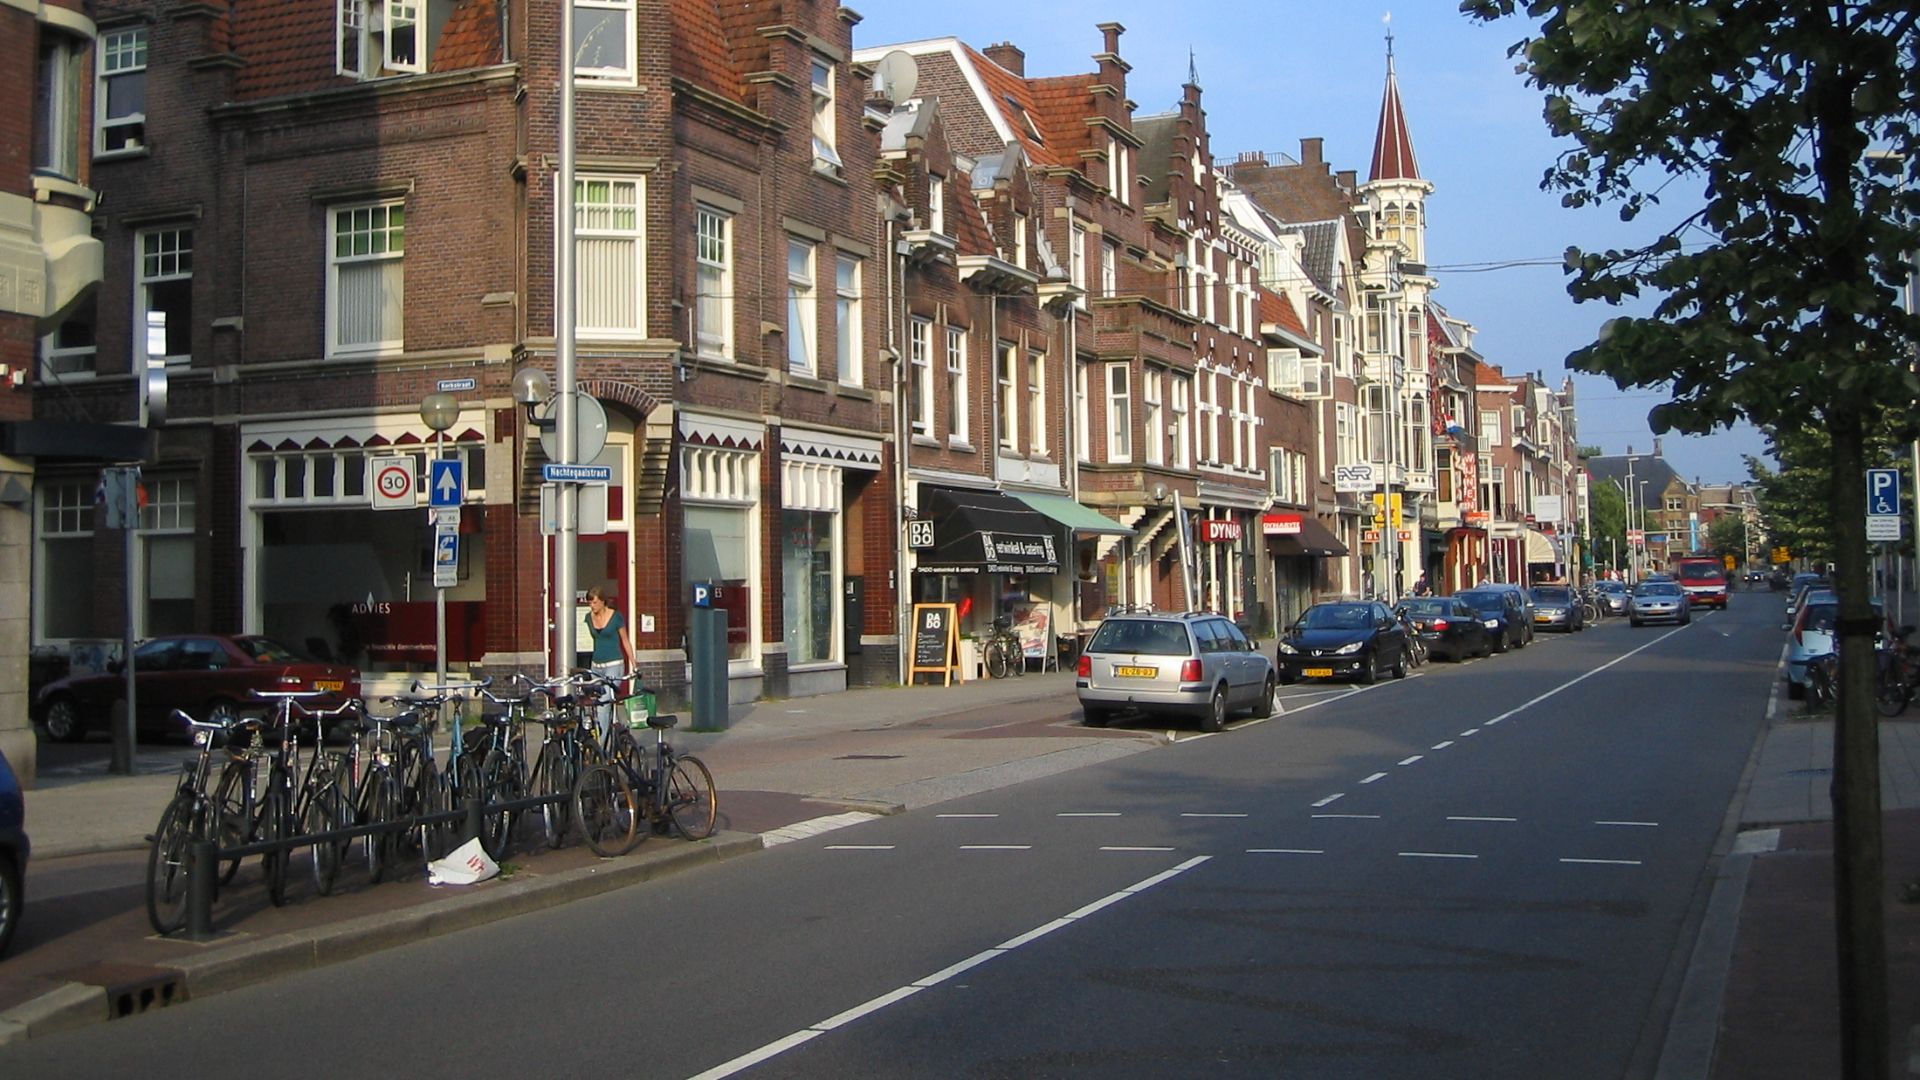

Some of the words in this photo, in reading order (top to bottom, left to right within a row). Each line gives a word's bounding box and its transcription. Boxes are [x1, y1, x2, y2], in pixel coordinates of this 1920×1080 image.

[550, 467, 608, 479] Nachtegaalstraat
[383, 476, 405, 490] 30
[1874, 472, 1892, 497] P
[912, 523, 931, 534] DA
[913, 534, 932, 545] DO
[695, 587, 708, 603] P
[352, 596, 391, 614] ADVIES
[926, 612, 941, 621] DA
[926, 620, 941, 629] DO
